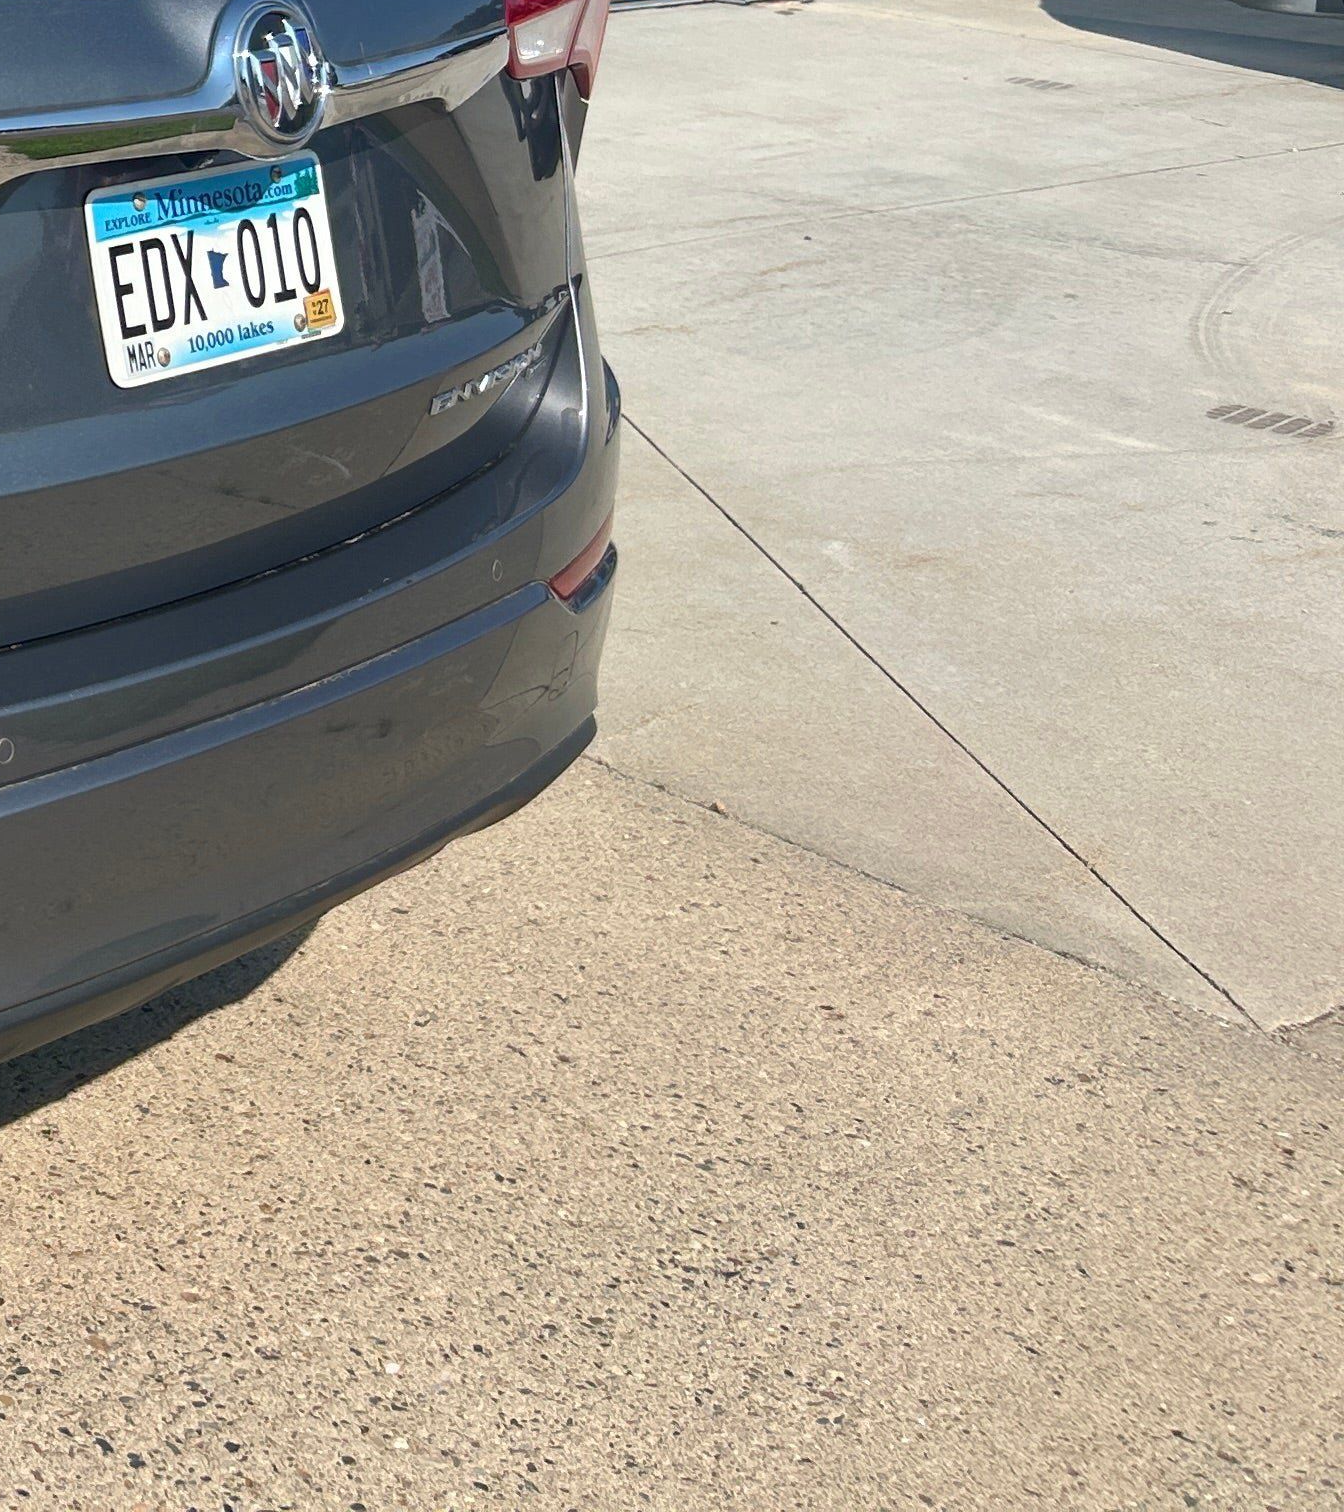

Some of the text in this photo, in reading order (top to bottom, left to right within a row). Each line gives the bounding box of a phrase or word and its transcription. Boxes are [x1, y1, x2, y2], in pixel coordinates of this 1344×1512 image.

[105, 212, 152, 231] EXPLORE
[109, 207, 321, 339] EDX 010
[316, 299, 329, 315] 27
[188, 328, 234, 353] 10,000
[237, 321, 275, 340] lakes
[127, 341, 157, 373] MAR
